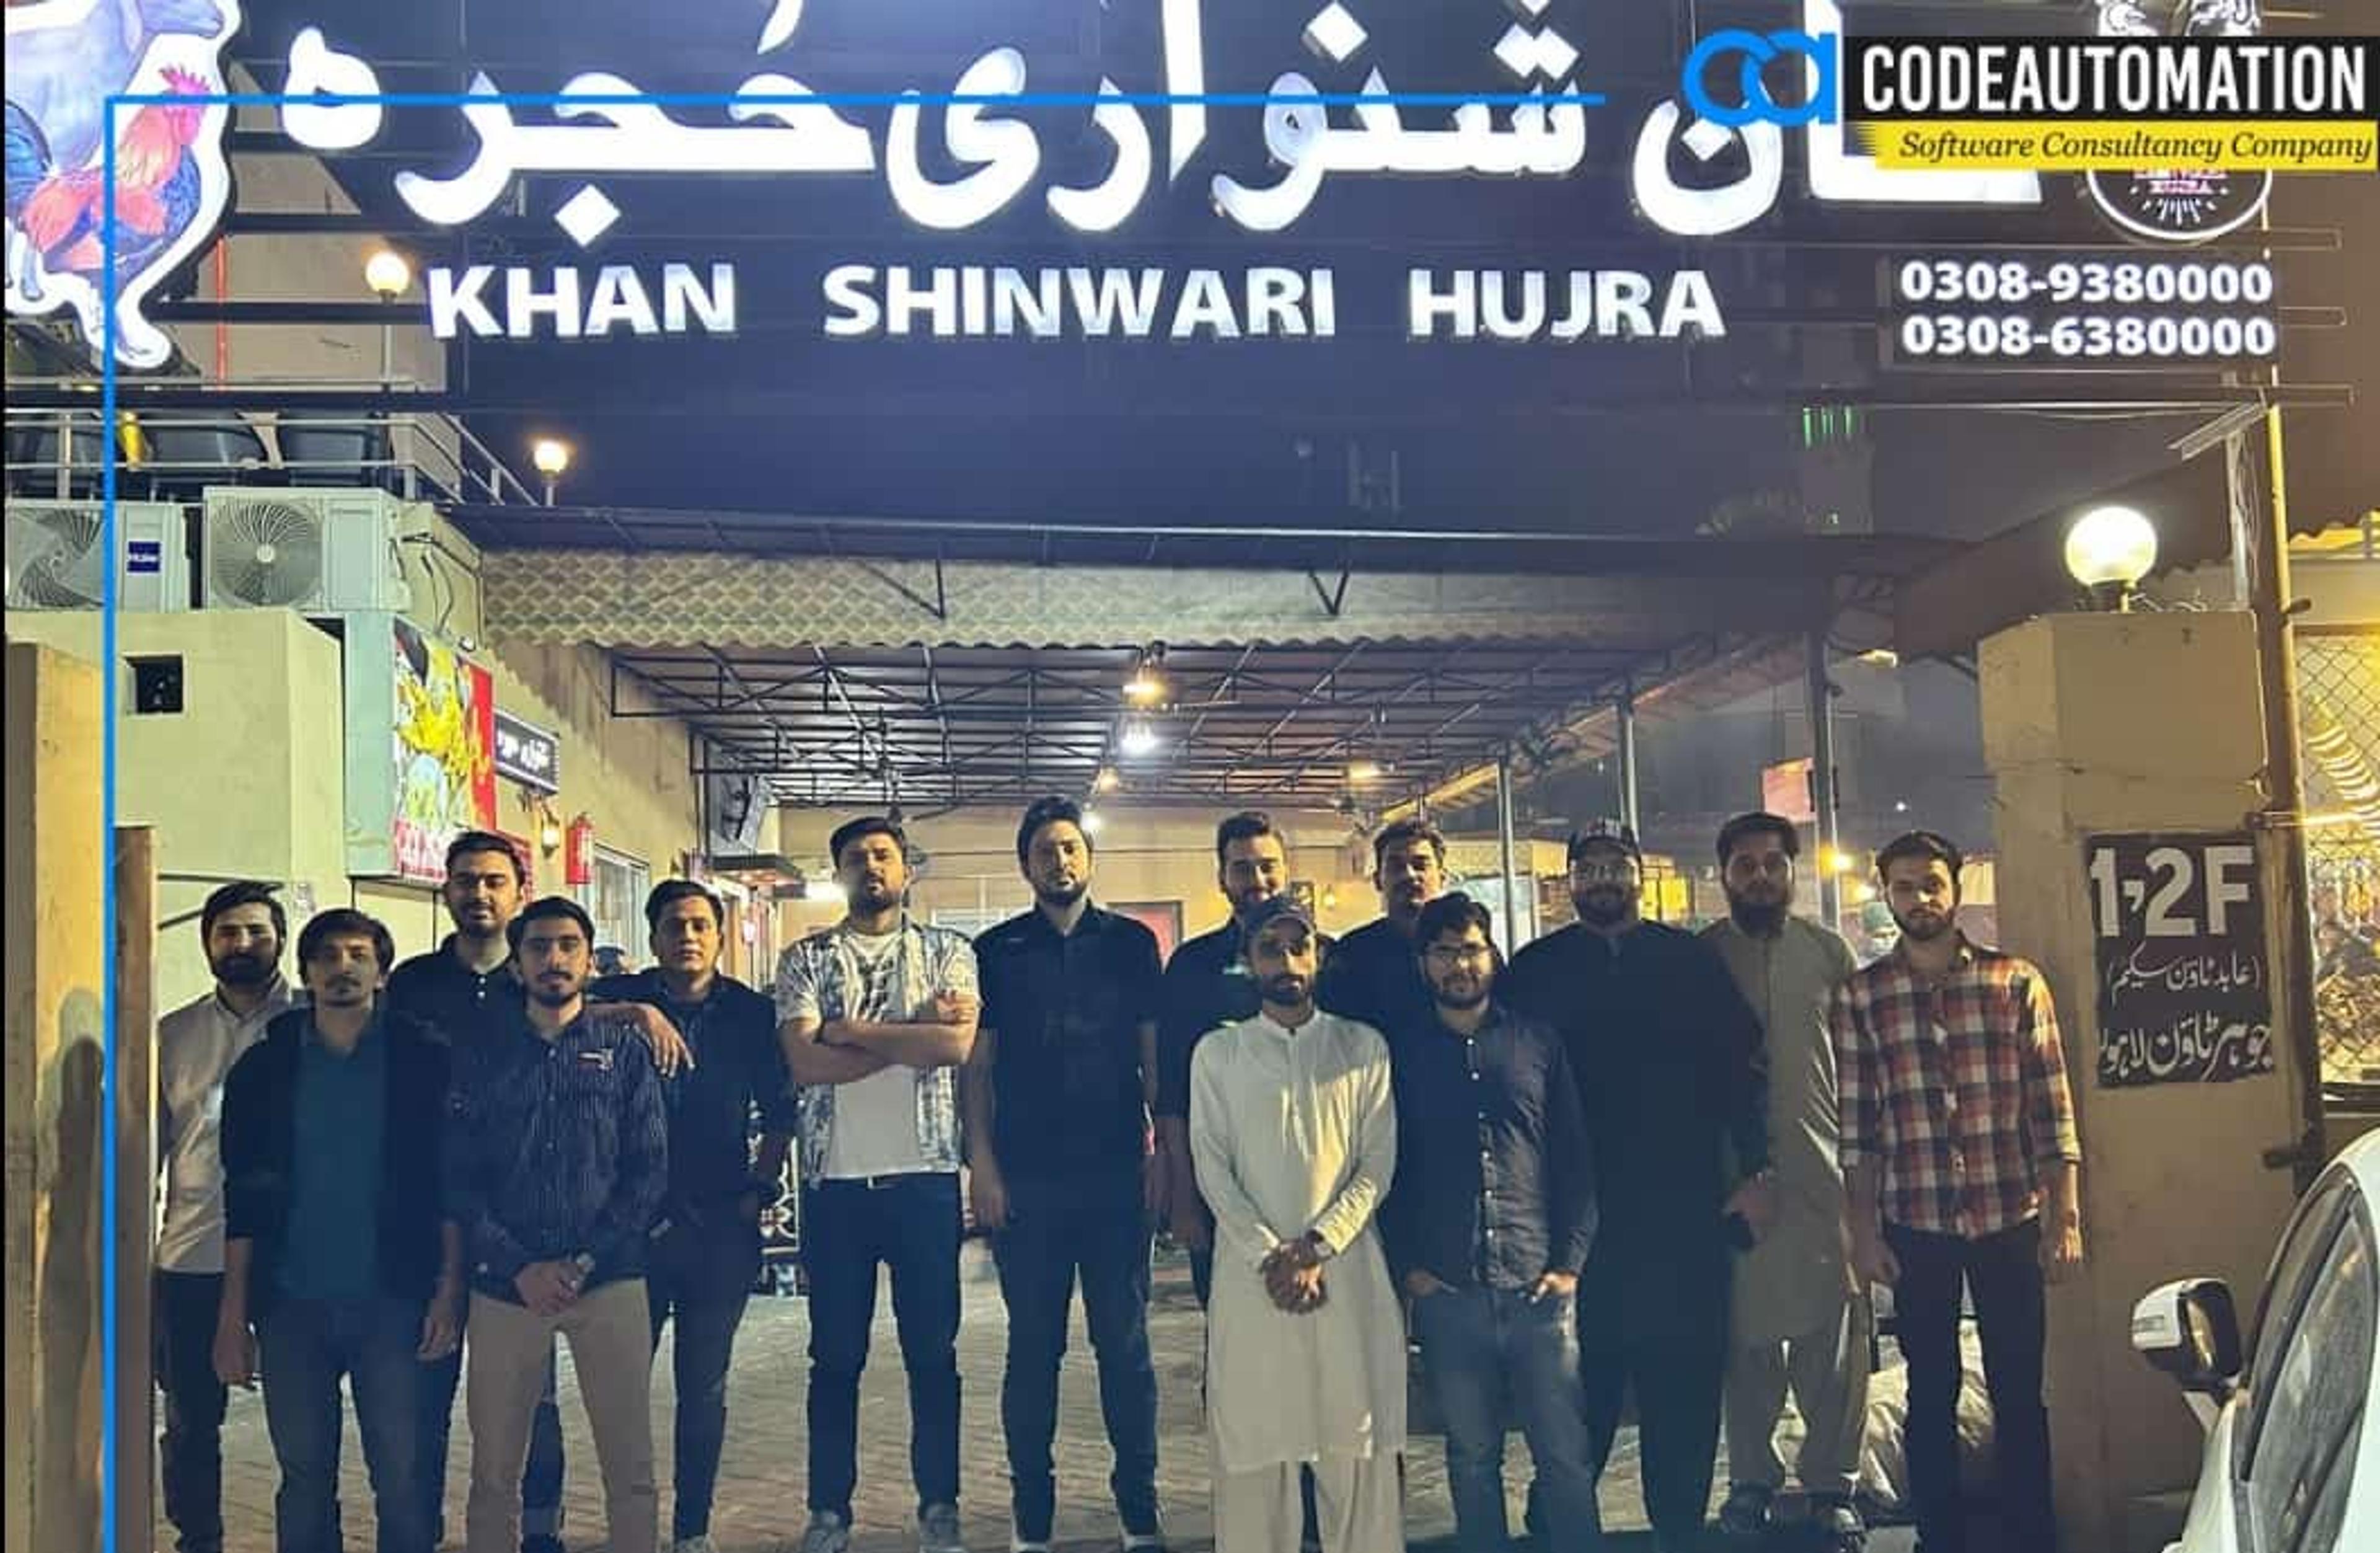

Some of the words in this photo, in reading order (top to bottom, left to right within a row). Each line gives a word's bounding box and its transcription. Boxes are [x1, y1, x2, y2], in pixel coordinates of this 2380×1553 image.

[428, 263, 738, 339] KHAN
[823, 264, 1337, 338] SHINWARI
[1406, 269, 1726, 339] HUJRA
[1900, 260, 2273, 303] 0308-9380000
[1902, 315, 2276, 356] 0308-6380000
